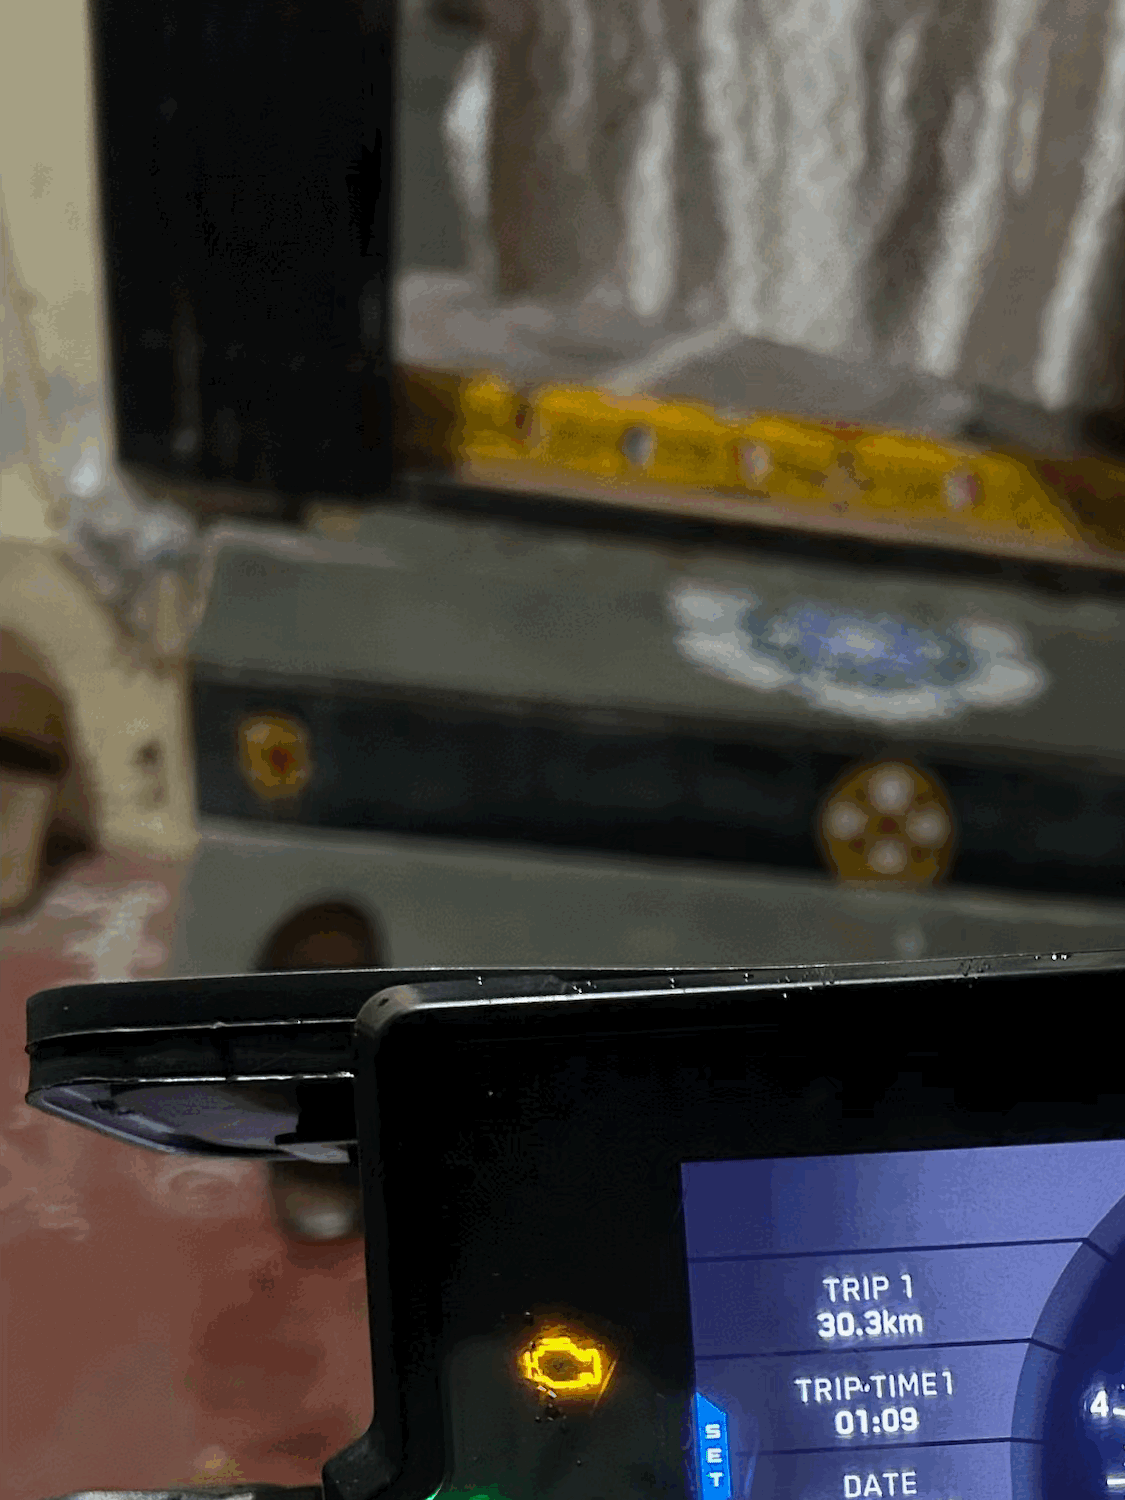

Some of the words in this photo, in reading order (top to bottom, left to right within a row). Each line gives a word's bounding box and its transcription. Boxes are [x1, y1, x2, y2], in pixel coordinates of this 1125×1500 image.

[823, 1275, 889, 1303] TRIP
[901, 1274, 912, 1299] 1
[817, 1309, 923, 1338] 30.3km
[1091, 1391, 1110, 1417] 4
[835, 1406, 920, 1435] 01:09
[845, 1472, 917, 1498] DATE
